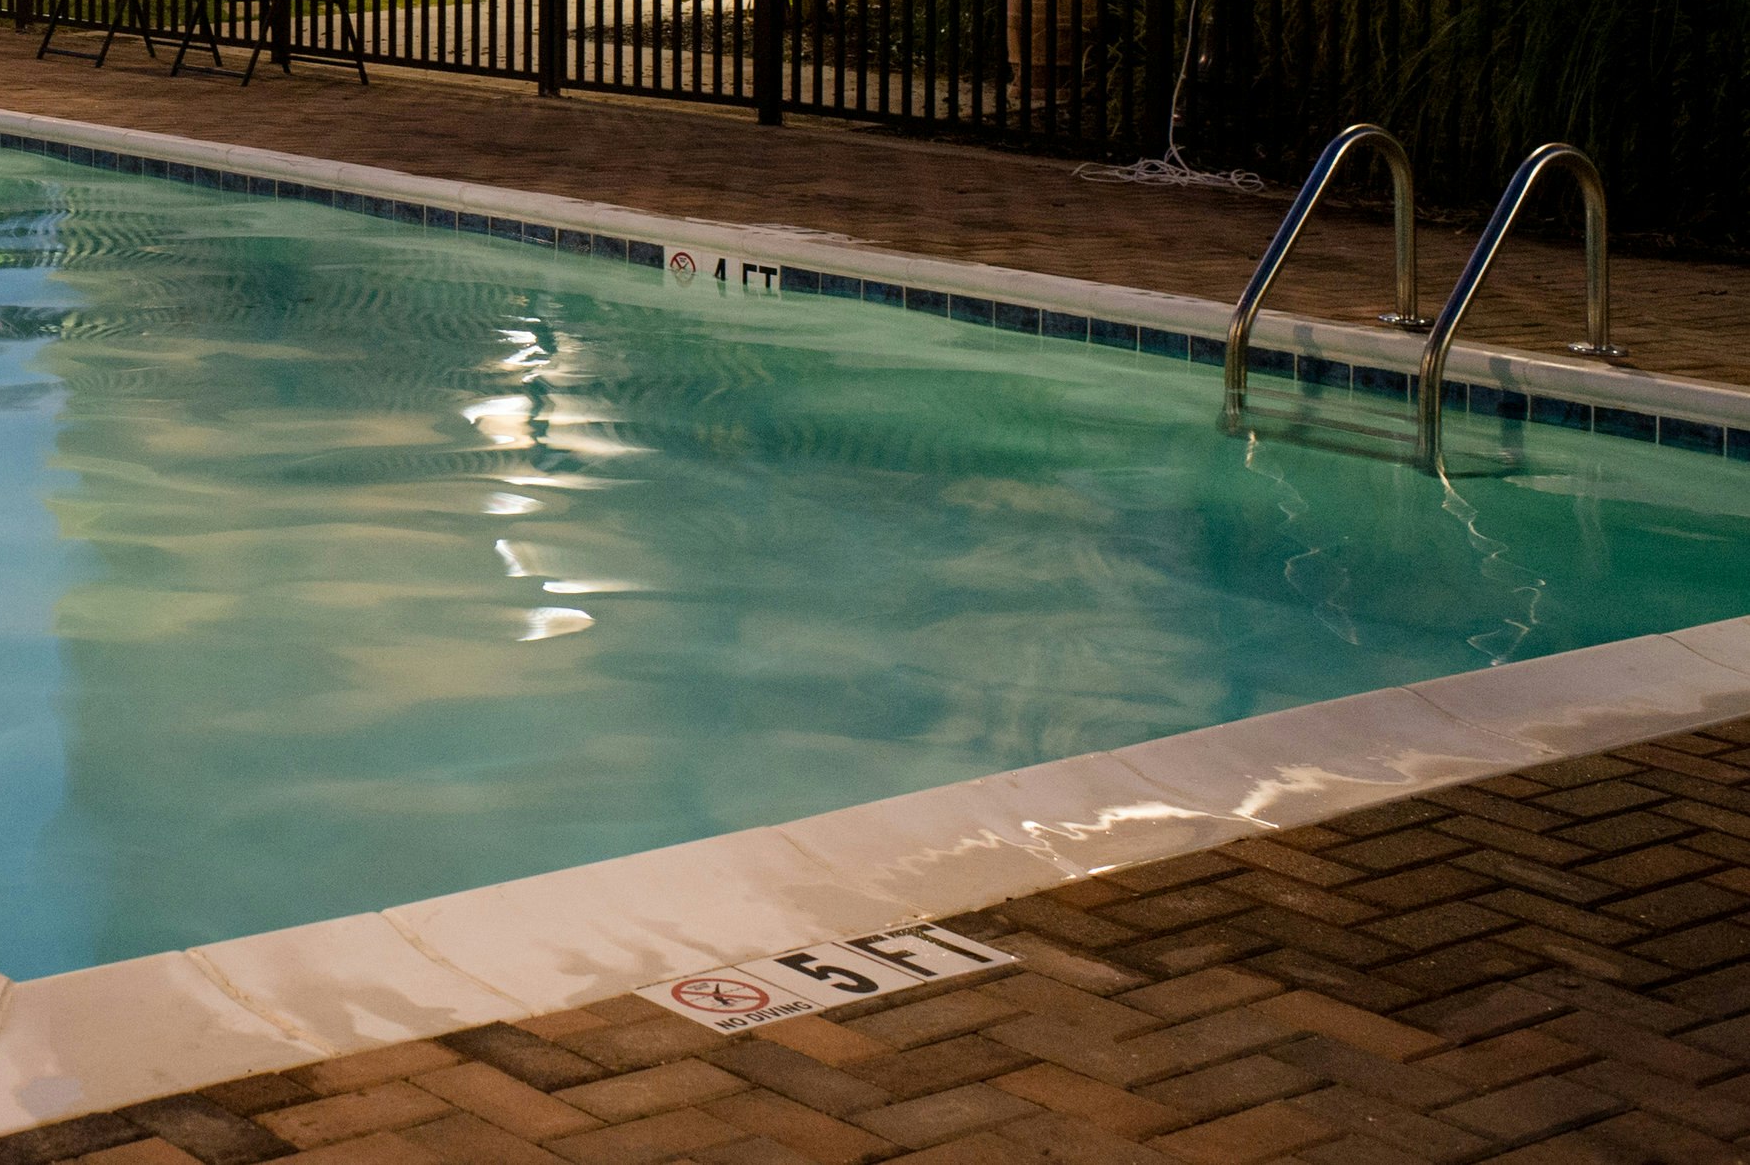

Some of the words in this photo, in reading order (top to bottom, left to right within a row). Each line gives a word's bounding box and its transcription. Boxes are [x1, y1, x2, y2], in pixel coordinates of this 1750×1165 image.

[773, 952, 880, 994] 5
[845, 923, 994, 977] FT
[714, 1017, 748, 1030] NO
[744, 1001, 813, 1022] DIVING
